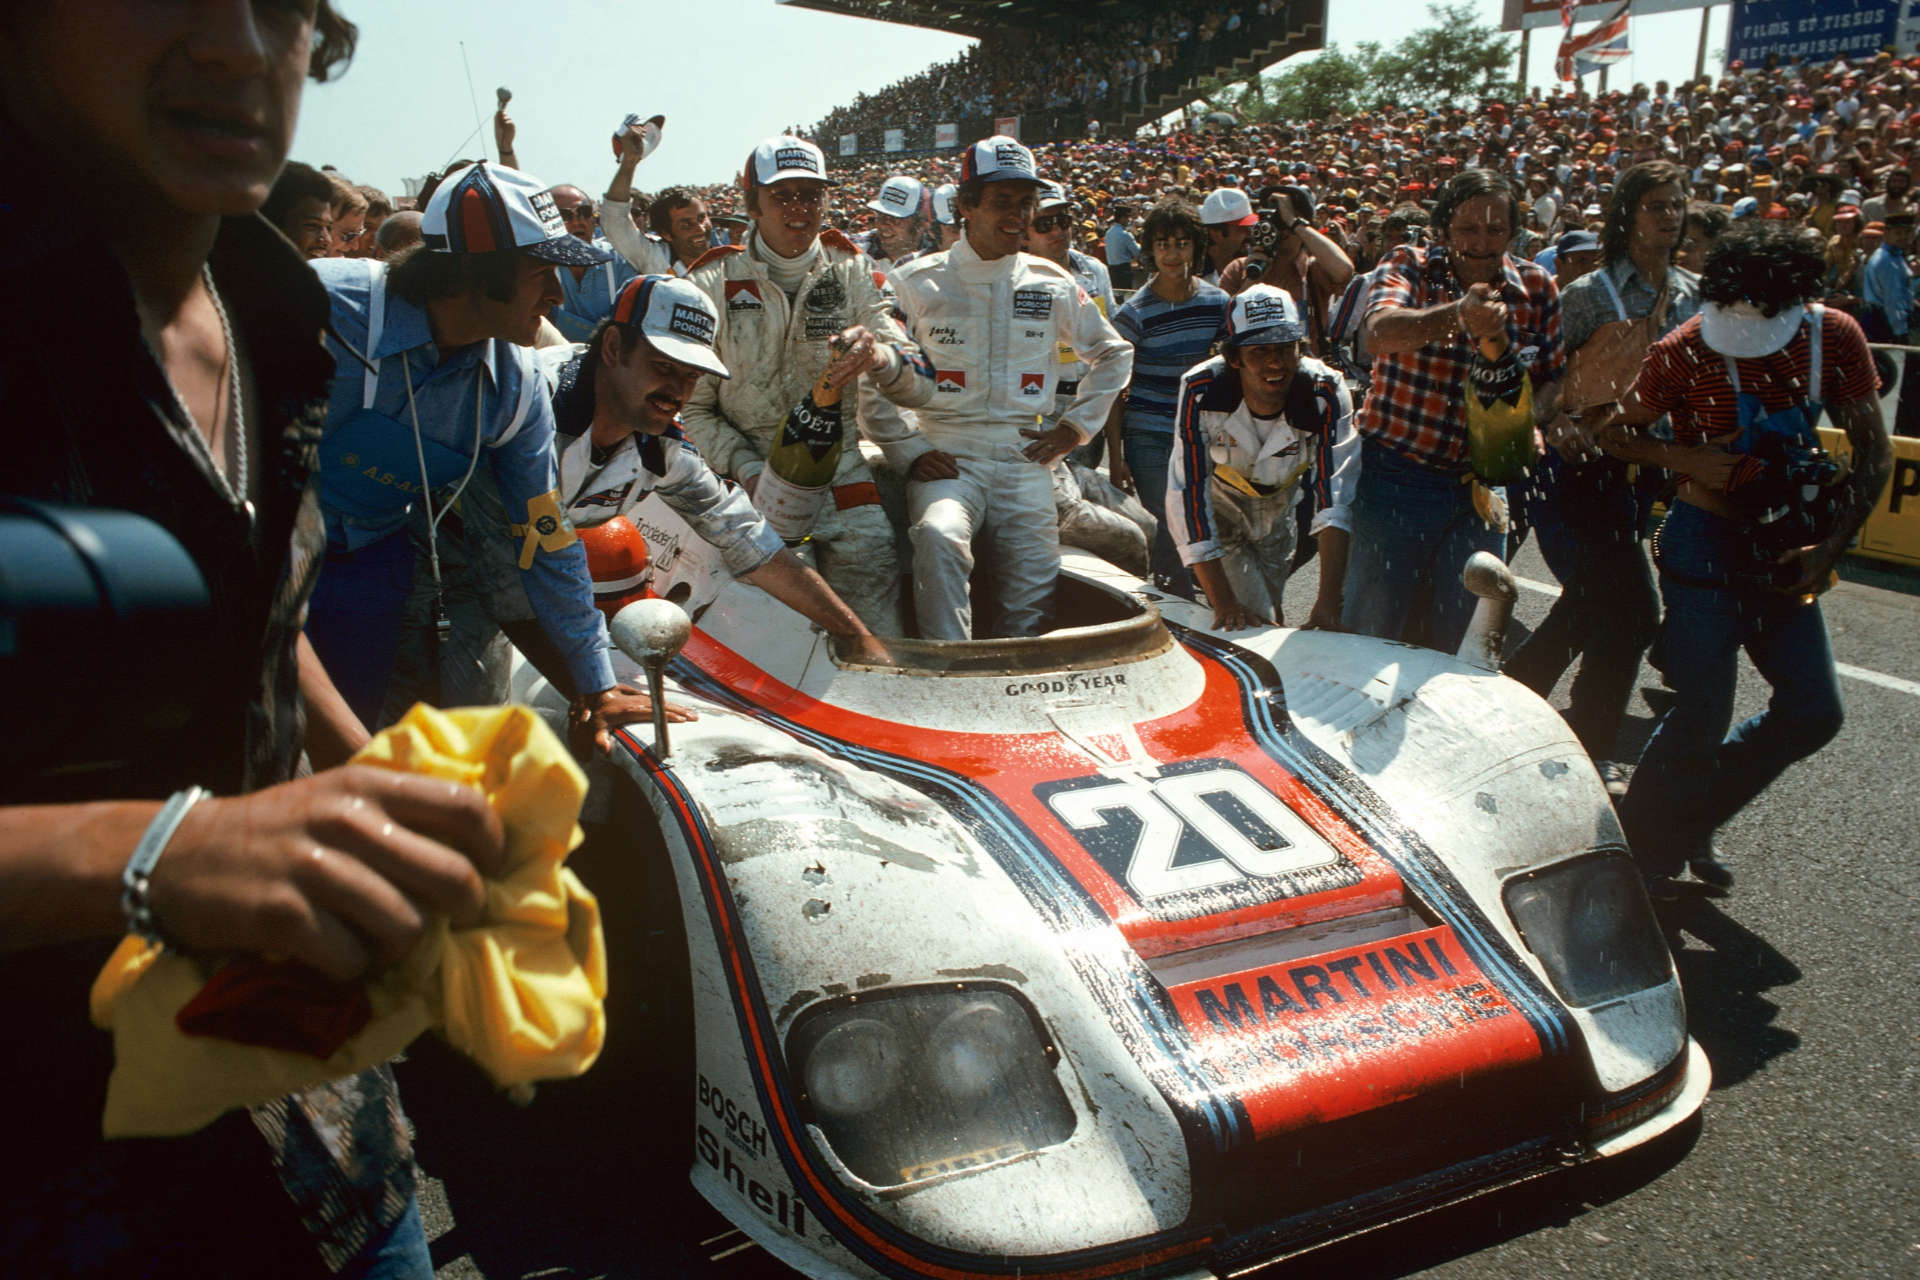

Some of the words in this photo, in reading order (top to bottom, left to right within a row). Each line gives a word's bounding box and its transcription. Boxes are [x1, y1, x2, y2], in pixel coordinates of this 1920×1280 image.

[1743, 21, 1790, 39] FILMS
[1798, 17, 1818, 33] ET
[1048, 767, 1343, 901] 20
[1195, 937, 1458, 1034] MARTINI
[1222, 982, 1512, 1082] ORSCHE
[698, 1073, 767, 1157] BOSCH
[697, 1124, 806, 1239] Shell
